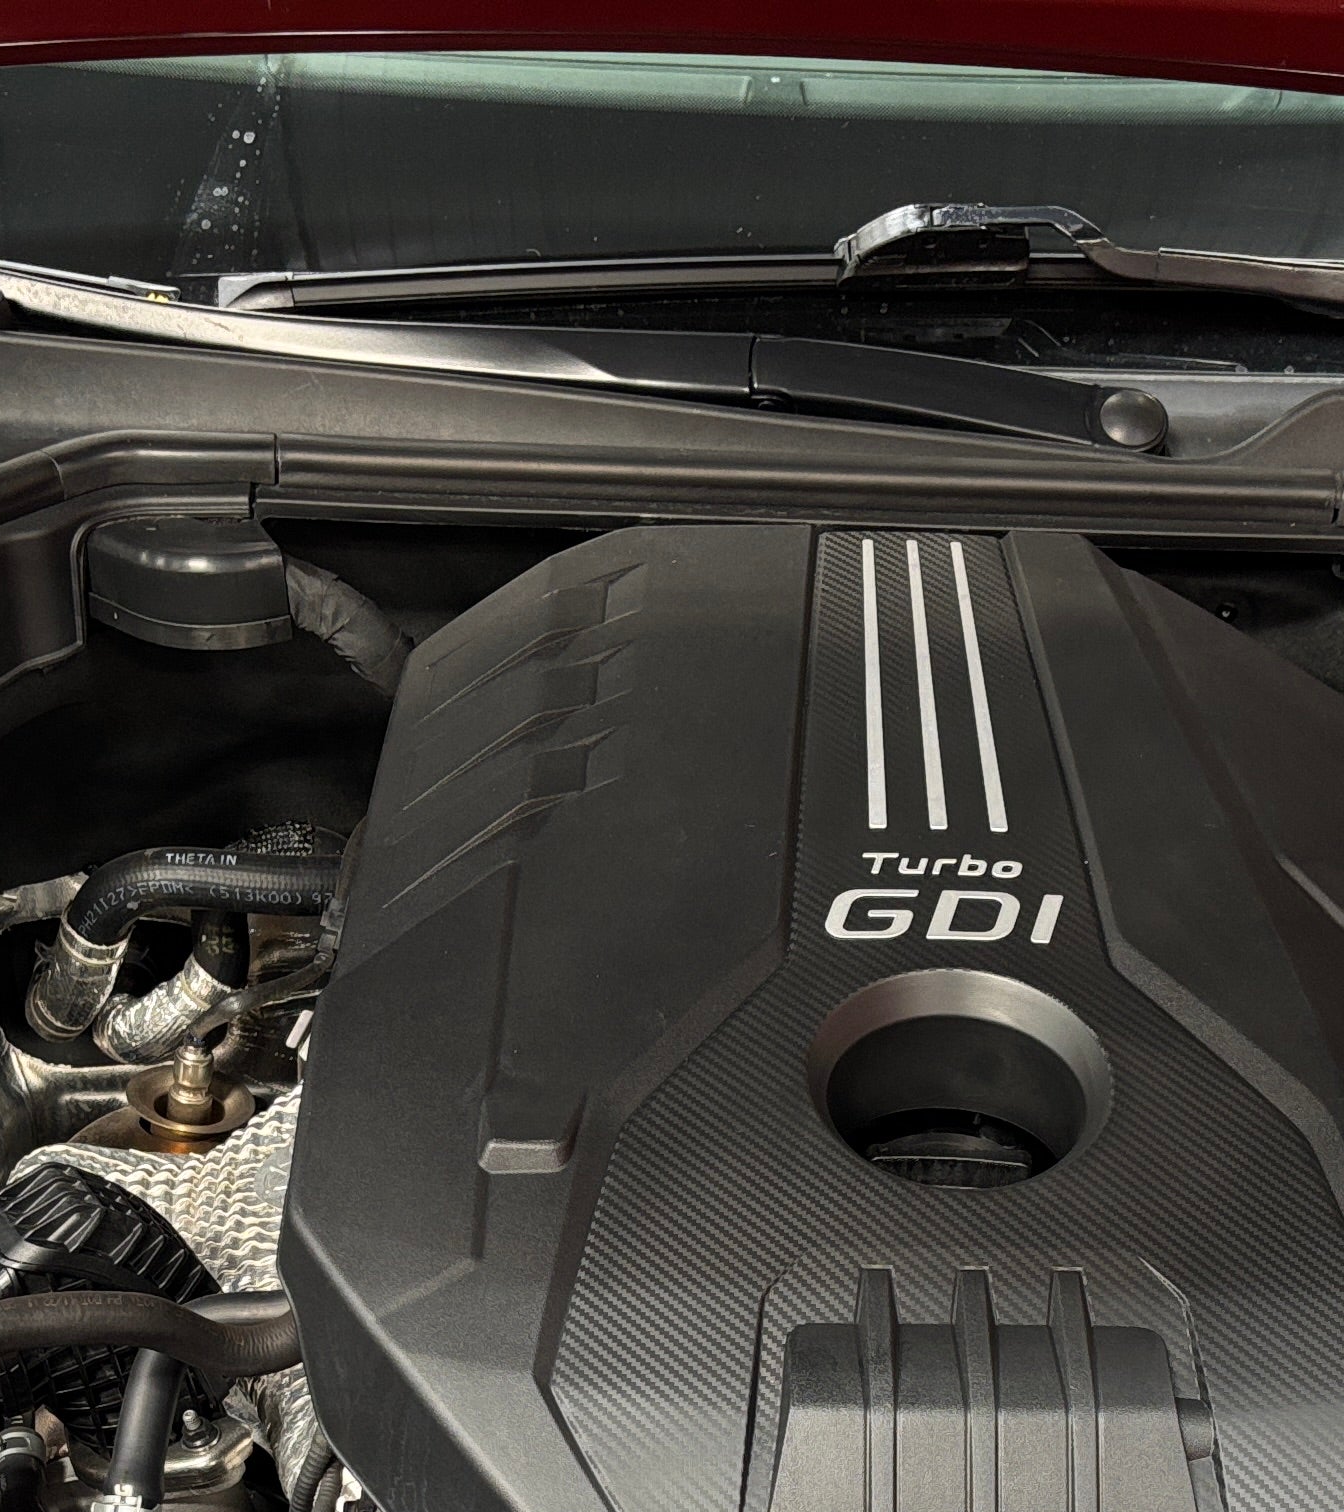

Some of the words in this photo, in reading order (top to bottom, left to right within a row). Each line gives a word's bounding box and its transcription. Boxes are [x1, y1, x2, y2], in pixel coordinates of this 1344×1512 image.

[166, 852, 215, 866] THETA
[220, 854, 238, 867] IN
[862, 852, 1023, 879] Turbo
[824, 888, 1064, 944] GDI
